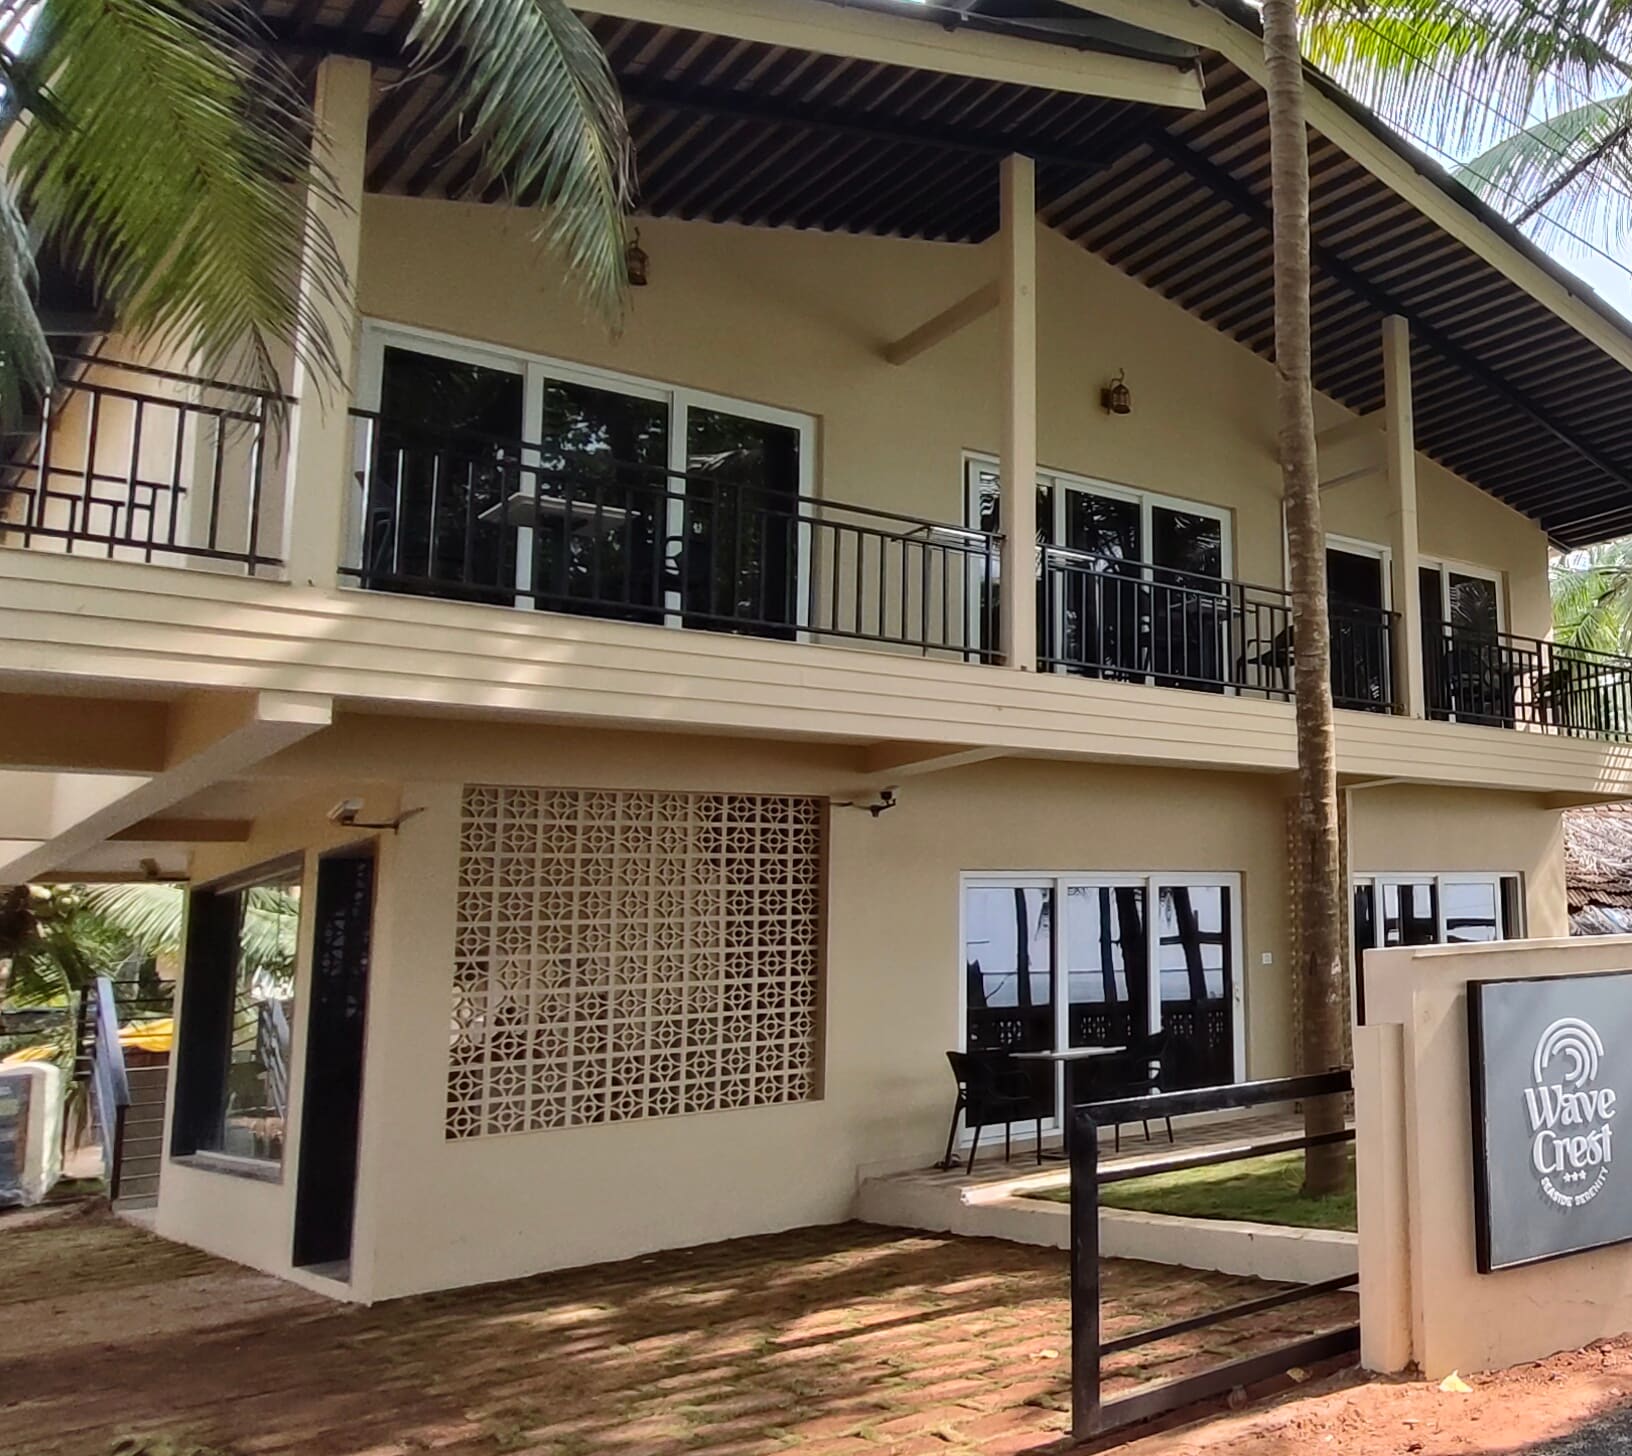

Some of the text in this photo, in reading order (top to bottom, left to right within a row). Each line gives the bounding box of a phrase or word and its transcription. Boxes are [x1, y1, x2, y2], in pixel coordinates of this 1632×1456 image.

[1524, 1085, 1617, 1131] Wave
[1532, 1123, 1613, 1174] Crest
[1541, 1166, 1609, 1207] SEASIDE SERENITY
